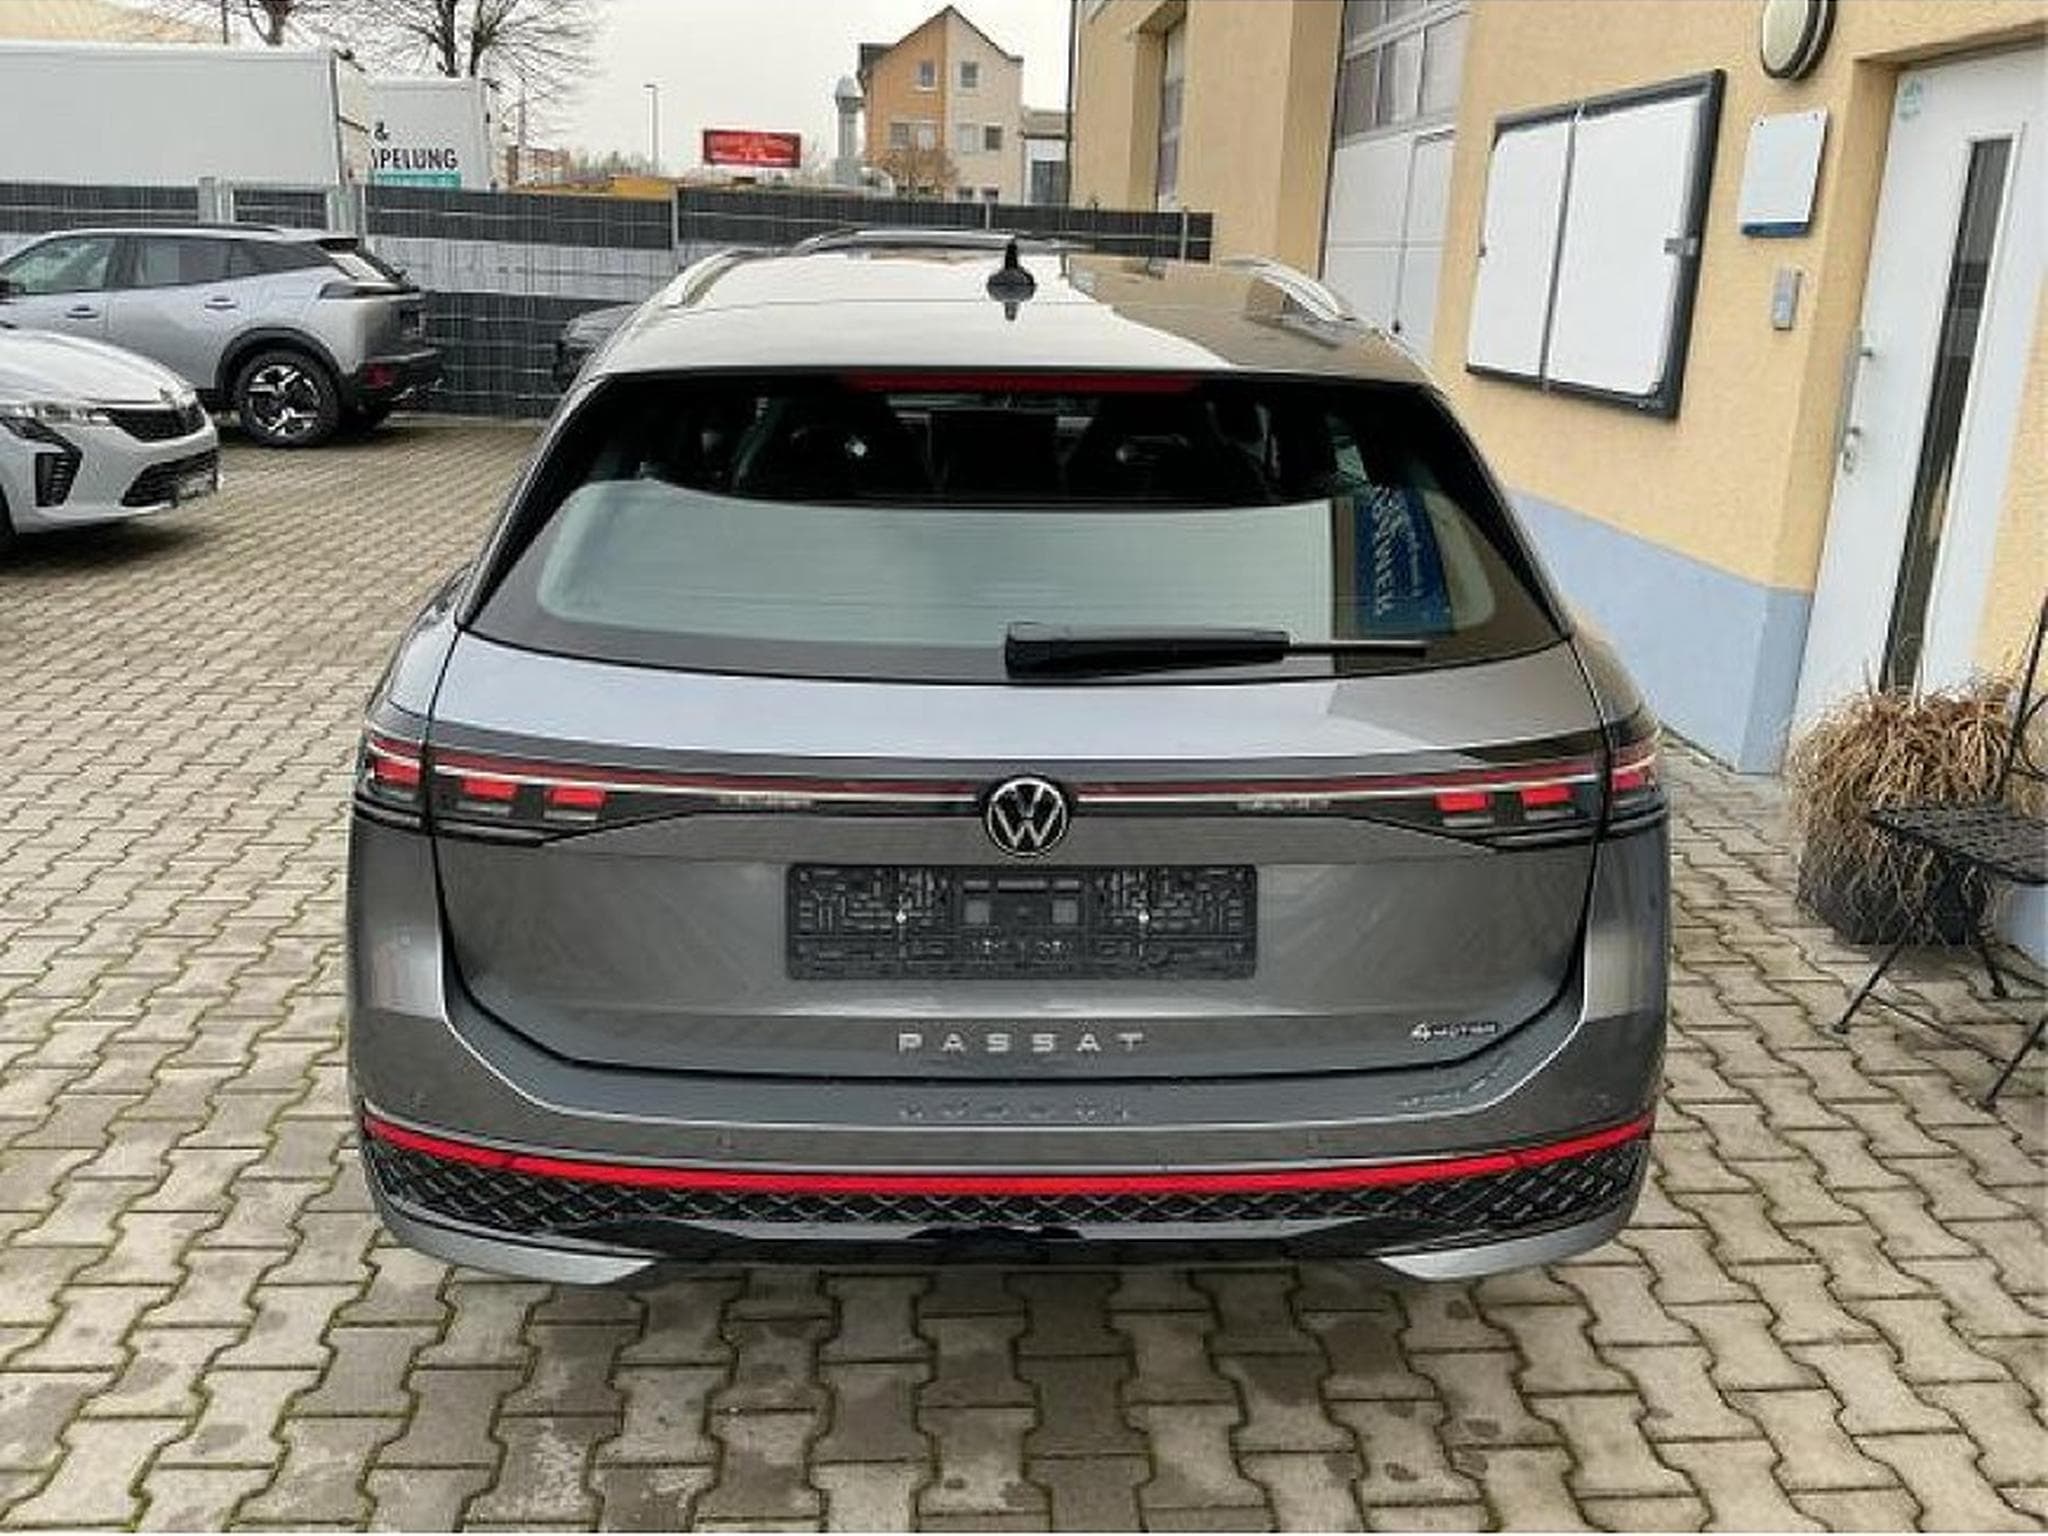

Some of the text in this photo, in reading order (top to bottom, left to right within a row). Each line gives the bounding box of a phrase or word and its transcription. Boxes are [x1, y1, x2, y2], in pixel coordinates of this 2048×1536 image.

[374, 121, 389, 141] &
[990, 782, 1064, 850] VW
[898, 1032, 1144, 1052] PASSAT
